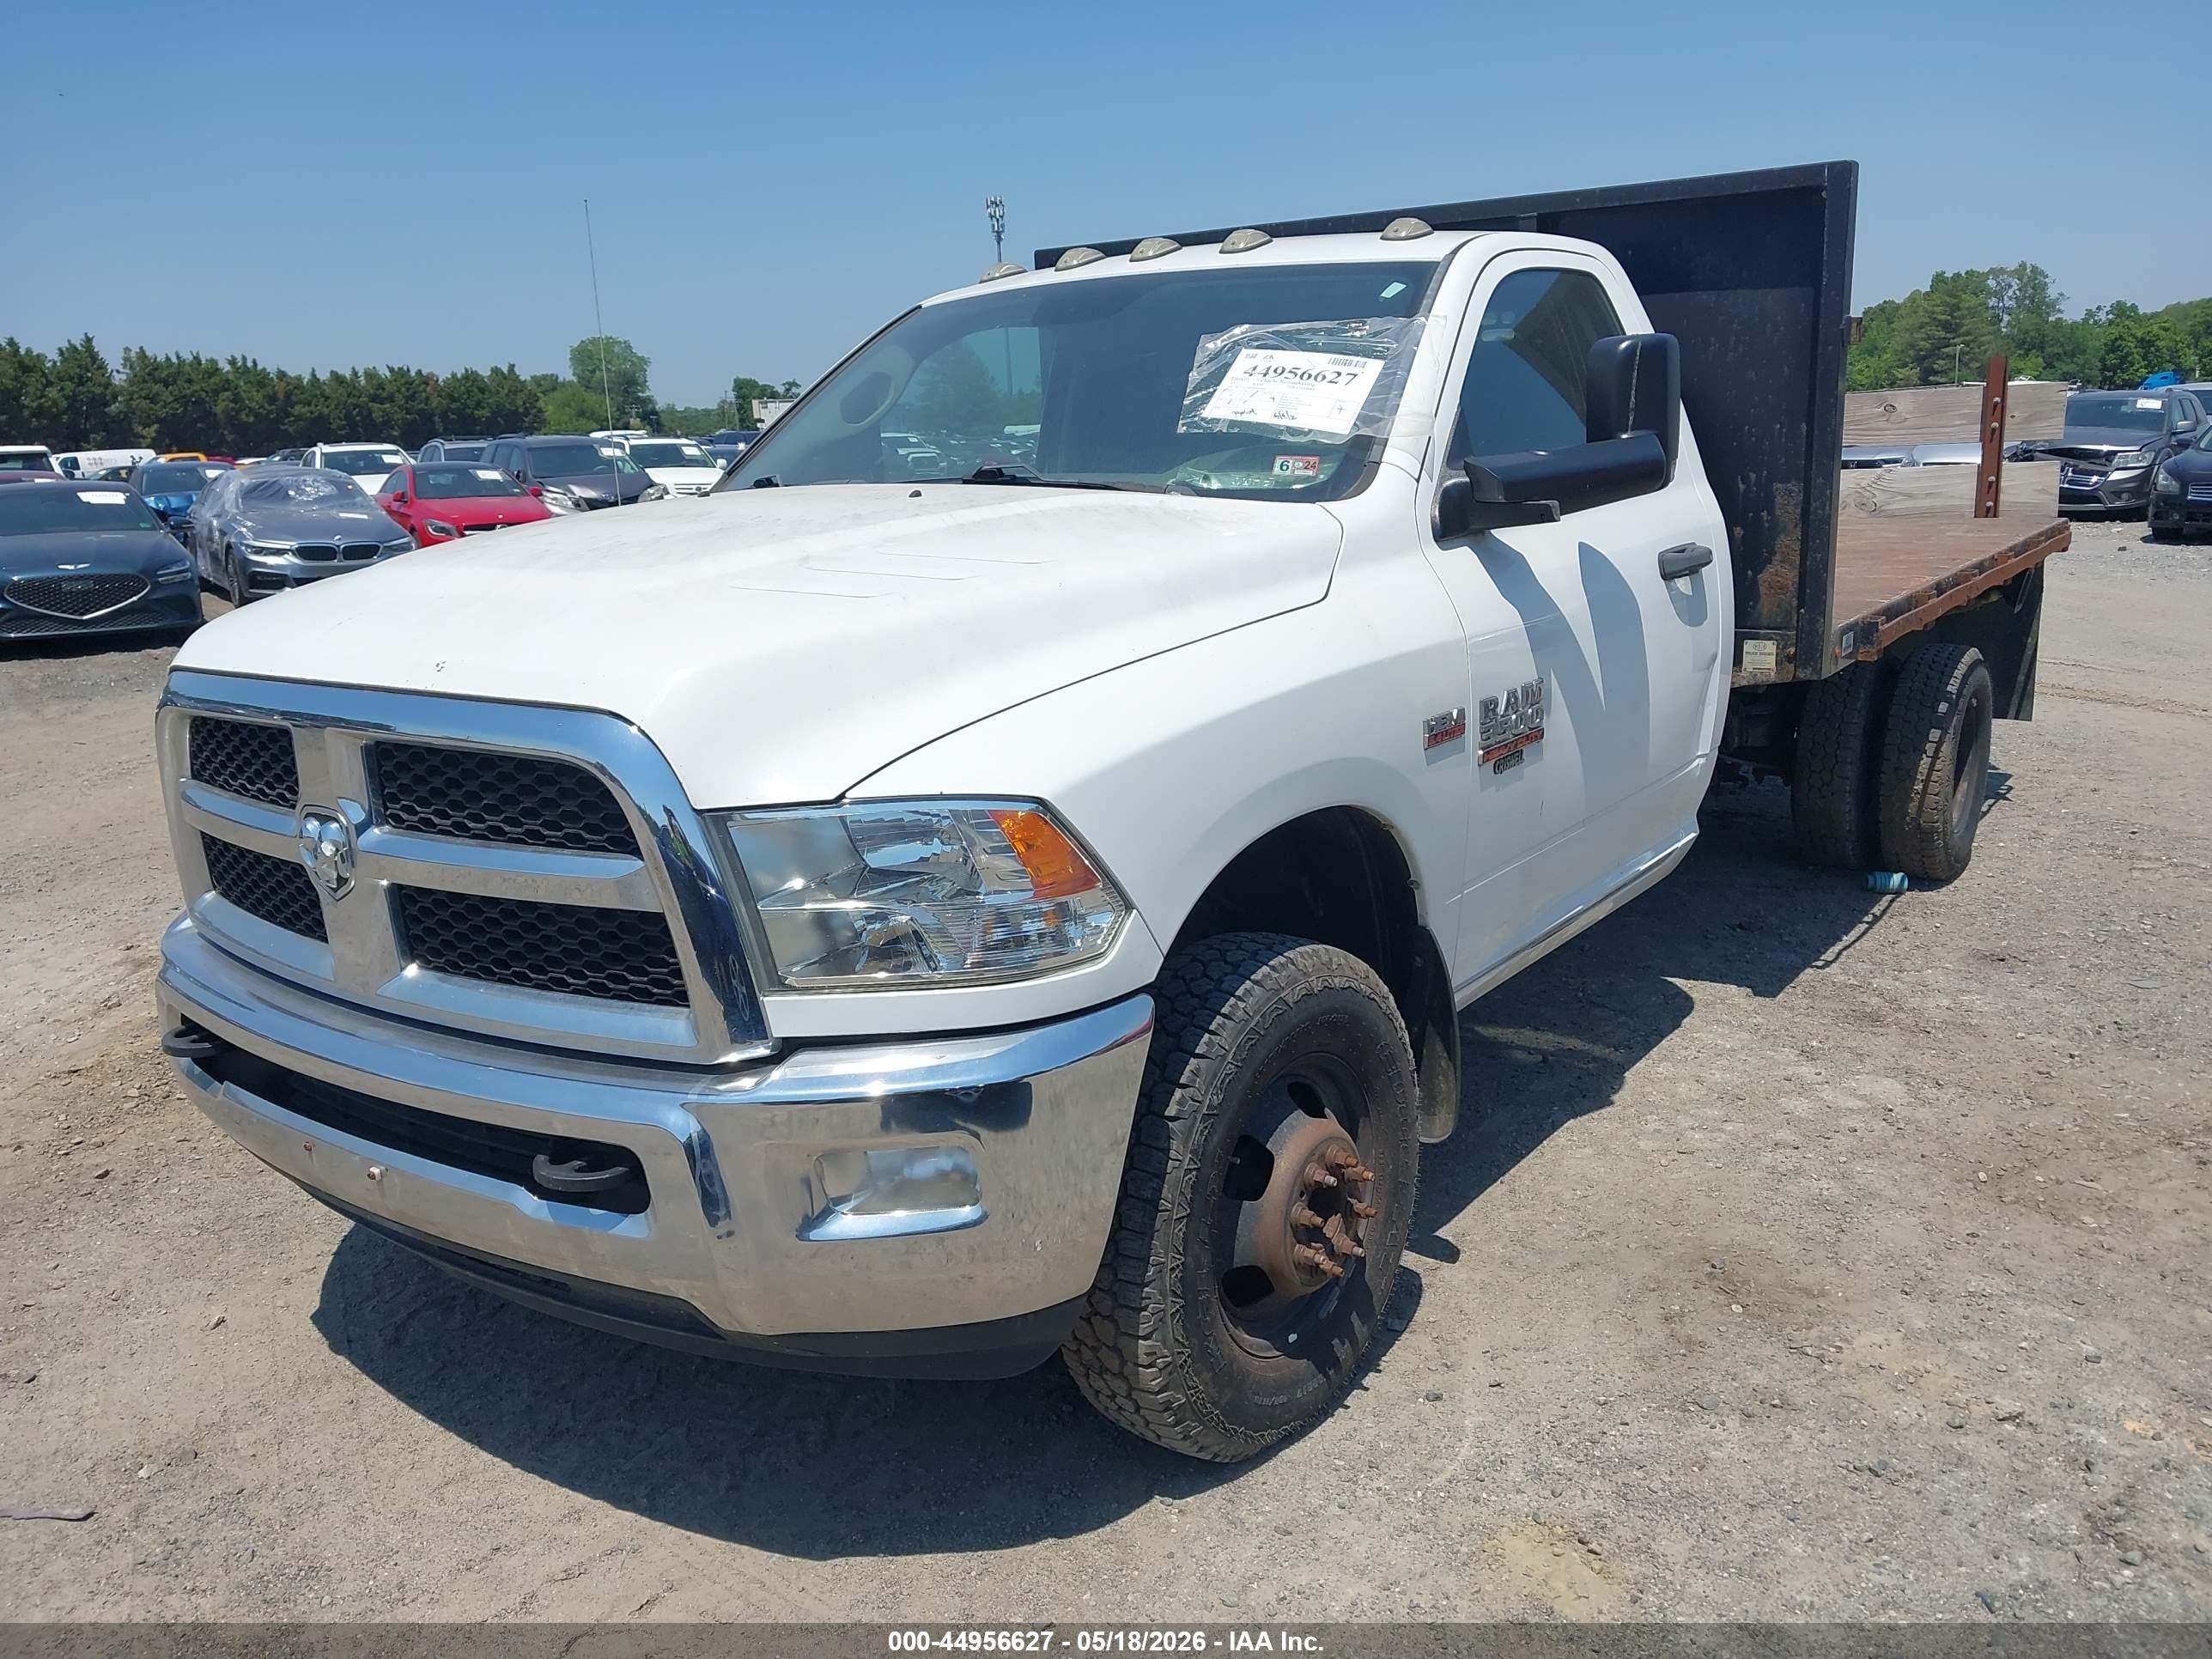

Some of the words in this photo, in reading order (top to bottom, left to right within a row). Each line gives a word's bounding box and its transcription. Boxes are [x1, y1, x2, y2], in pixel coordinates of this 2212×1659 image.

[1243, 364, 1358, 386] 44956627
[1279, 460, 1290, 471] 6
[1304, 460, 1317, 470] 24
[1479, 678, 1545, 725] RAM
[1479, 704, 1545, 744] 3500
